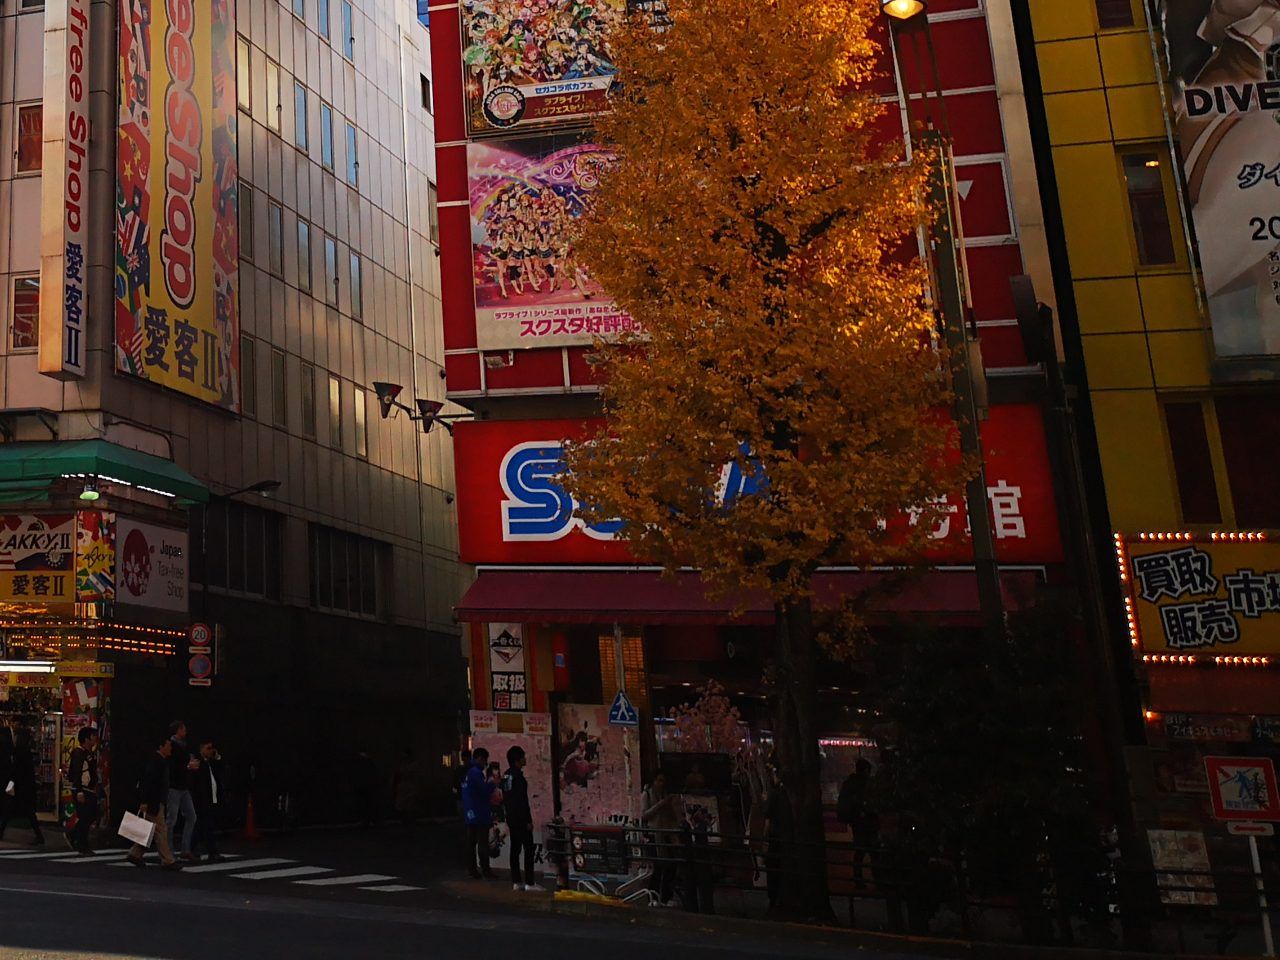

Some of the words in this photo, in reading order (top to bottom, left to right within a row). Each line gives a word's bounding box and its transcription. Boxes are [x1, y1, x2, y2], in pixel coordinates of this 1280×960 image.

[534, 82, 594, 95] セガコラボカフェ
[1185, 82, 1280, 117] DIVE
[66, 110, 88, 234] Shop
[161, 86, 202, 310] Shop
[4, 533, 59, 550] AKKY
[1134, 546, 1219, 603] 買取
[195, 630, 206, 640] 20
[1160, 599, 1239, 648] 販売
[493, 673, 526, 692] 取扱
